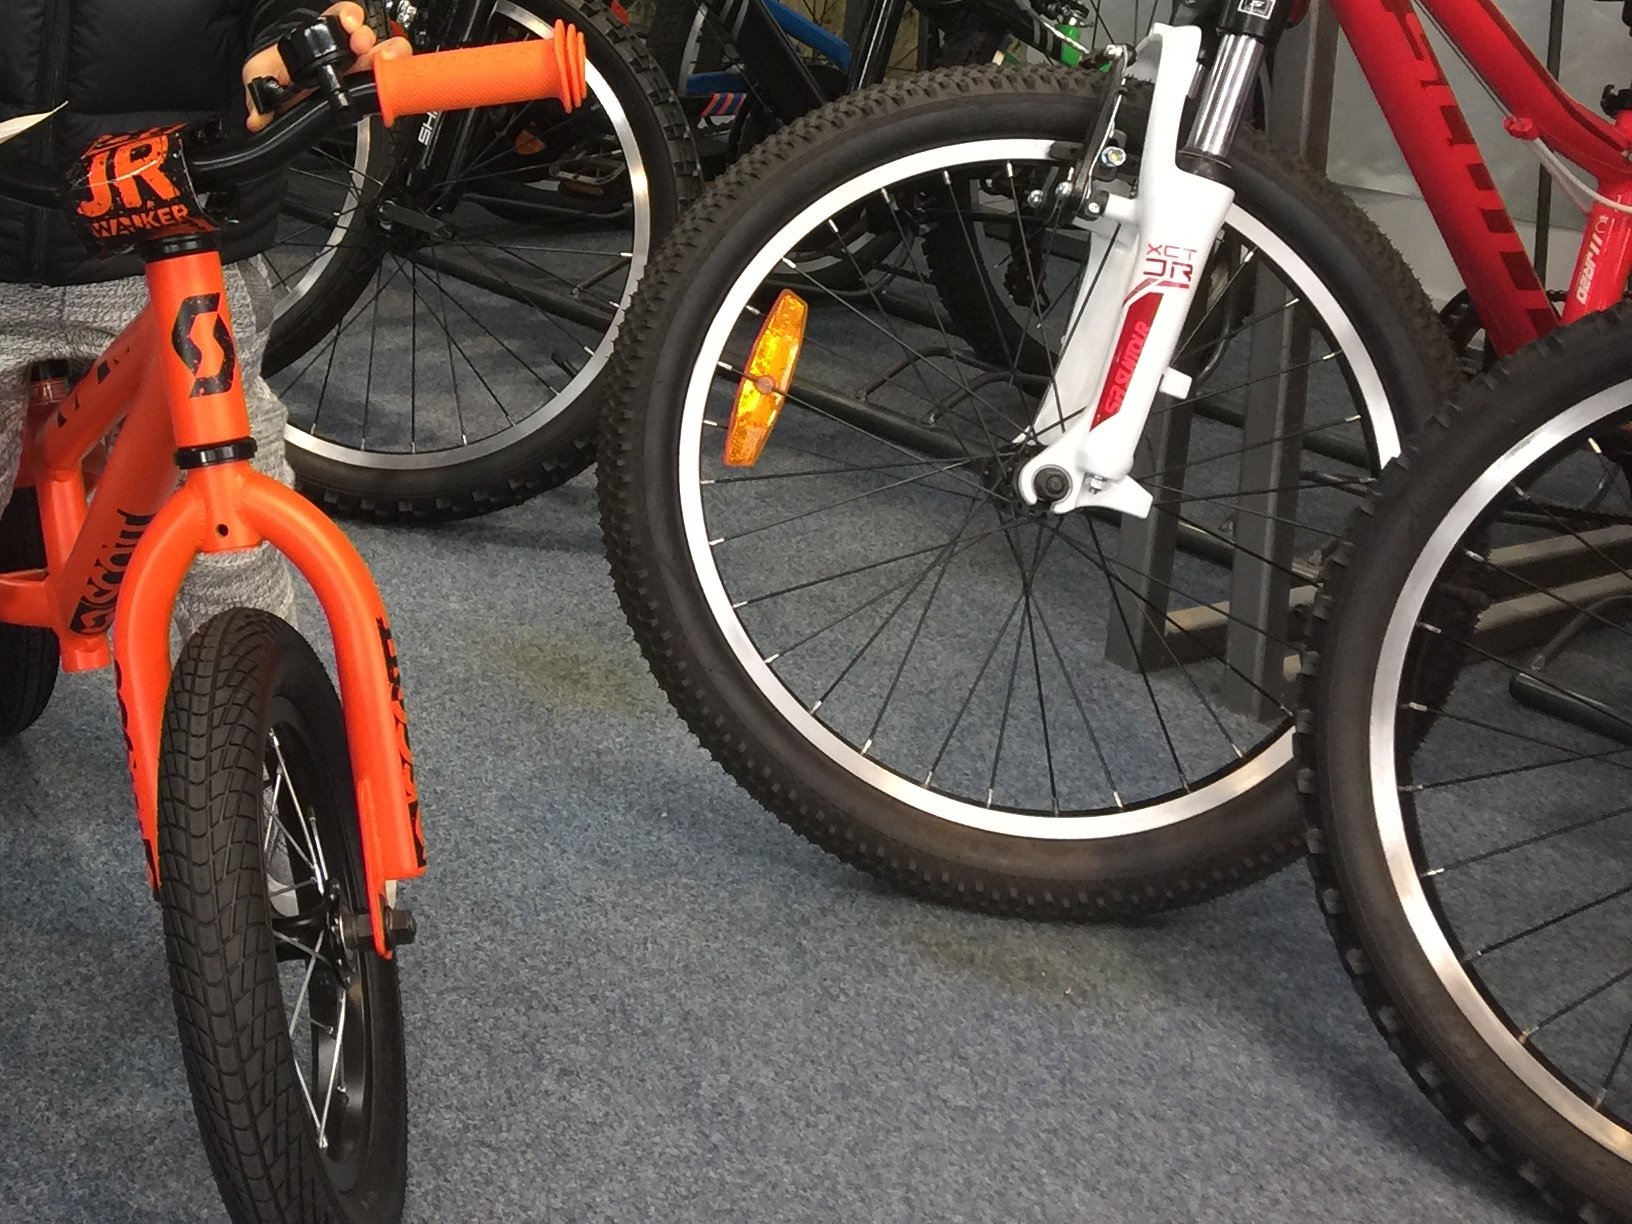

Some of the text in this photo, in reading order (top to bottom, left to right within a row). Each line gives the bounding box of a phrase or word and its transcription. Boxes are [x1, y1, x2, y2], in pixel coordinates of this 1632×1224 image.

[76, 134, 180, 217] JR
[90, 203, 189, 238] WALKER
[1147, 242, 1197, 261] XCT
[1143, 257, 1193, 282] JR
